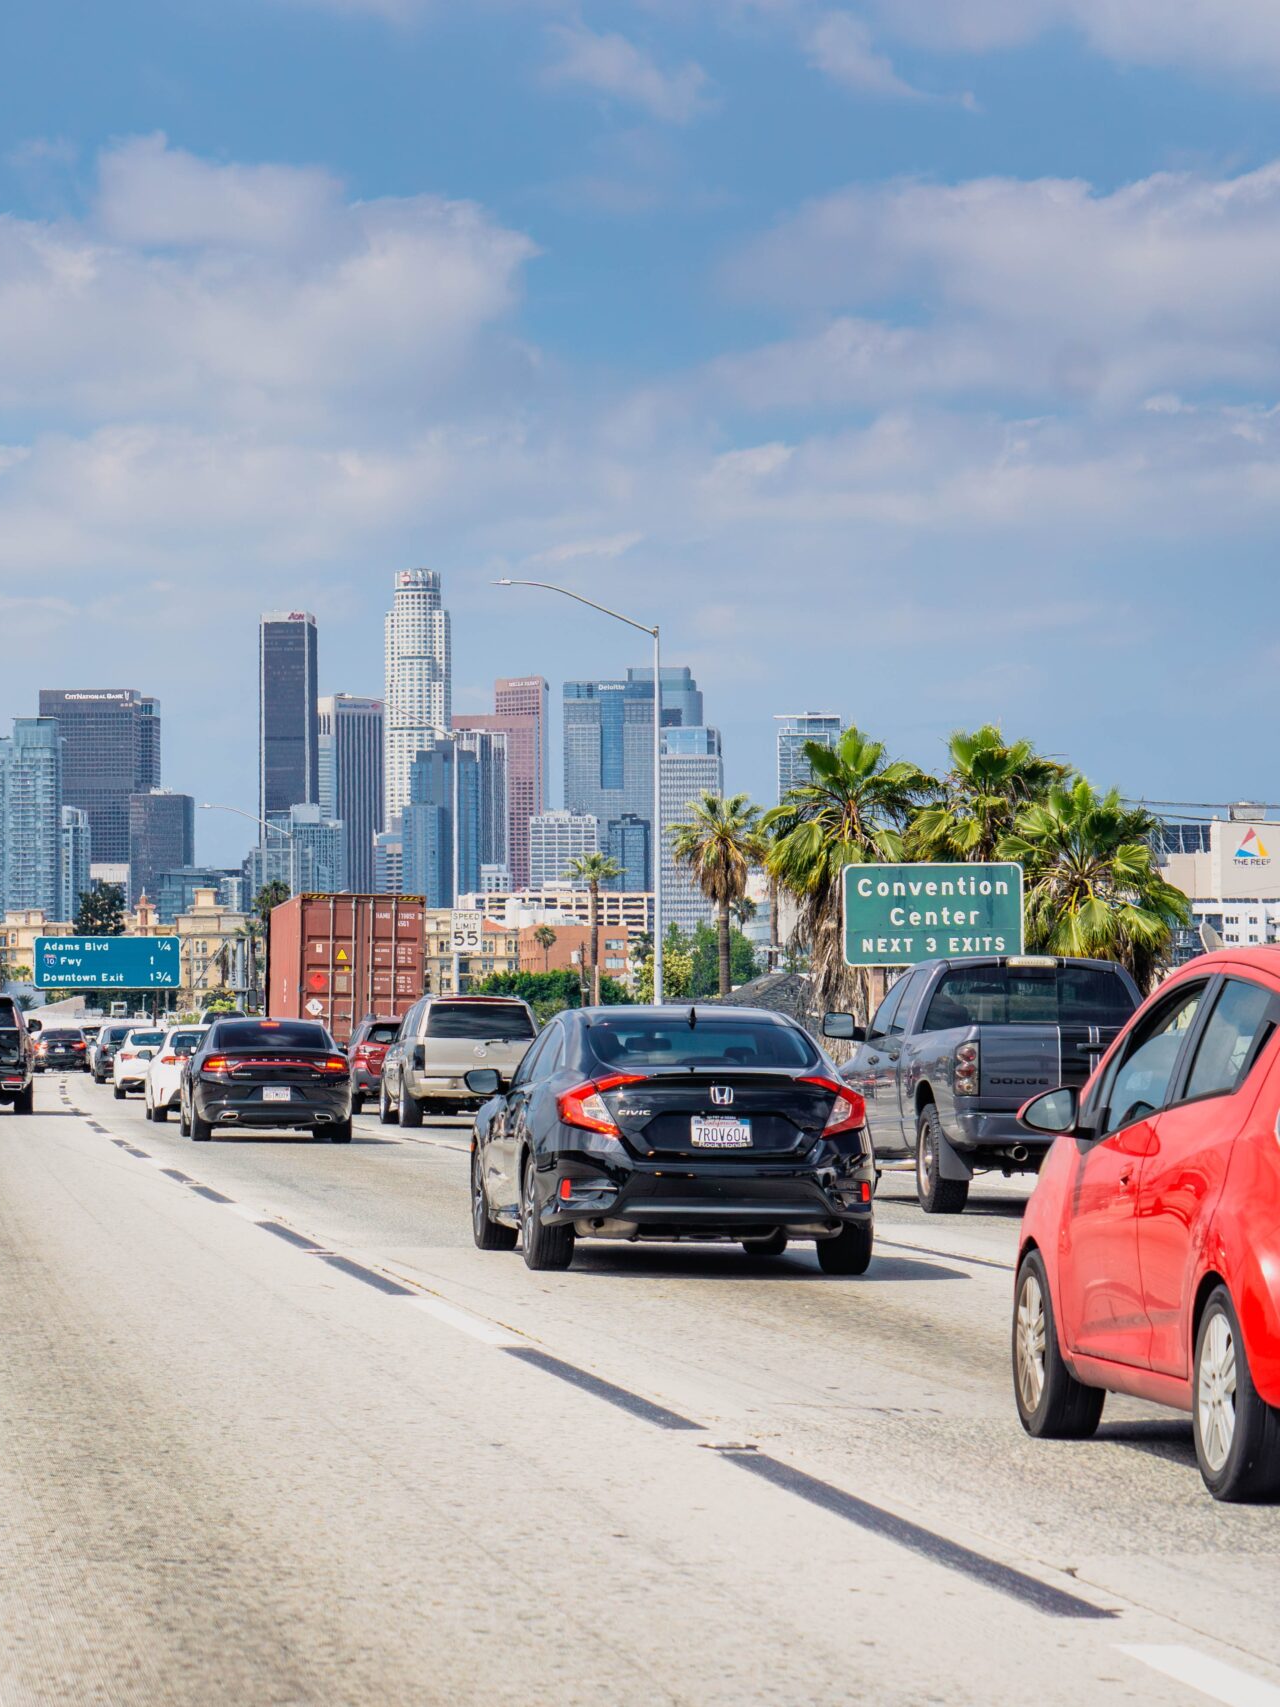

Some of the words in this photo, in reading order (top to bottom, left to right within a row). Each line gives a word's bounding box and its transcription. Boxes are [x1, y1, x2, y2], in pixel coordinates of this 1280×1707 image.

[1233, 858, 1249, 866] THE
[1250, 858, 1271, 866] REEF
[857, 876, 1009, 897] Convention
[890, 906, 980, 926] Center
[455, 922, 477, 930] LIMIT
[453, 930, 479, 946] 55
[43, 942, 80, 951] Adams
[84, 942, 110, 951] Blvd
[862, 938, 913, 953] NEXT
[925, 937, 937, 952] 3
[949, 936, 1006, 952] EXITS
[60, 956, 82, 966] Fwy
[149, 956, 154, 965] 1
[43, 973, 97, 982] Downtown
[101, 973, 124, 982] Exit
[990, 1077, 1049, 1085] DODGE
[703, 1119, 737, 1127] California
